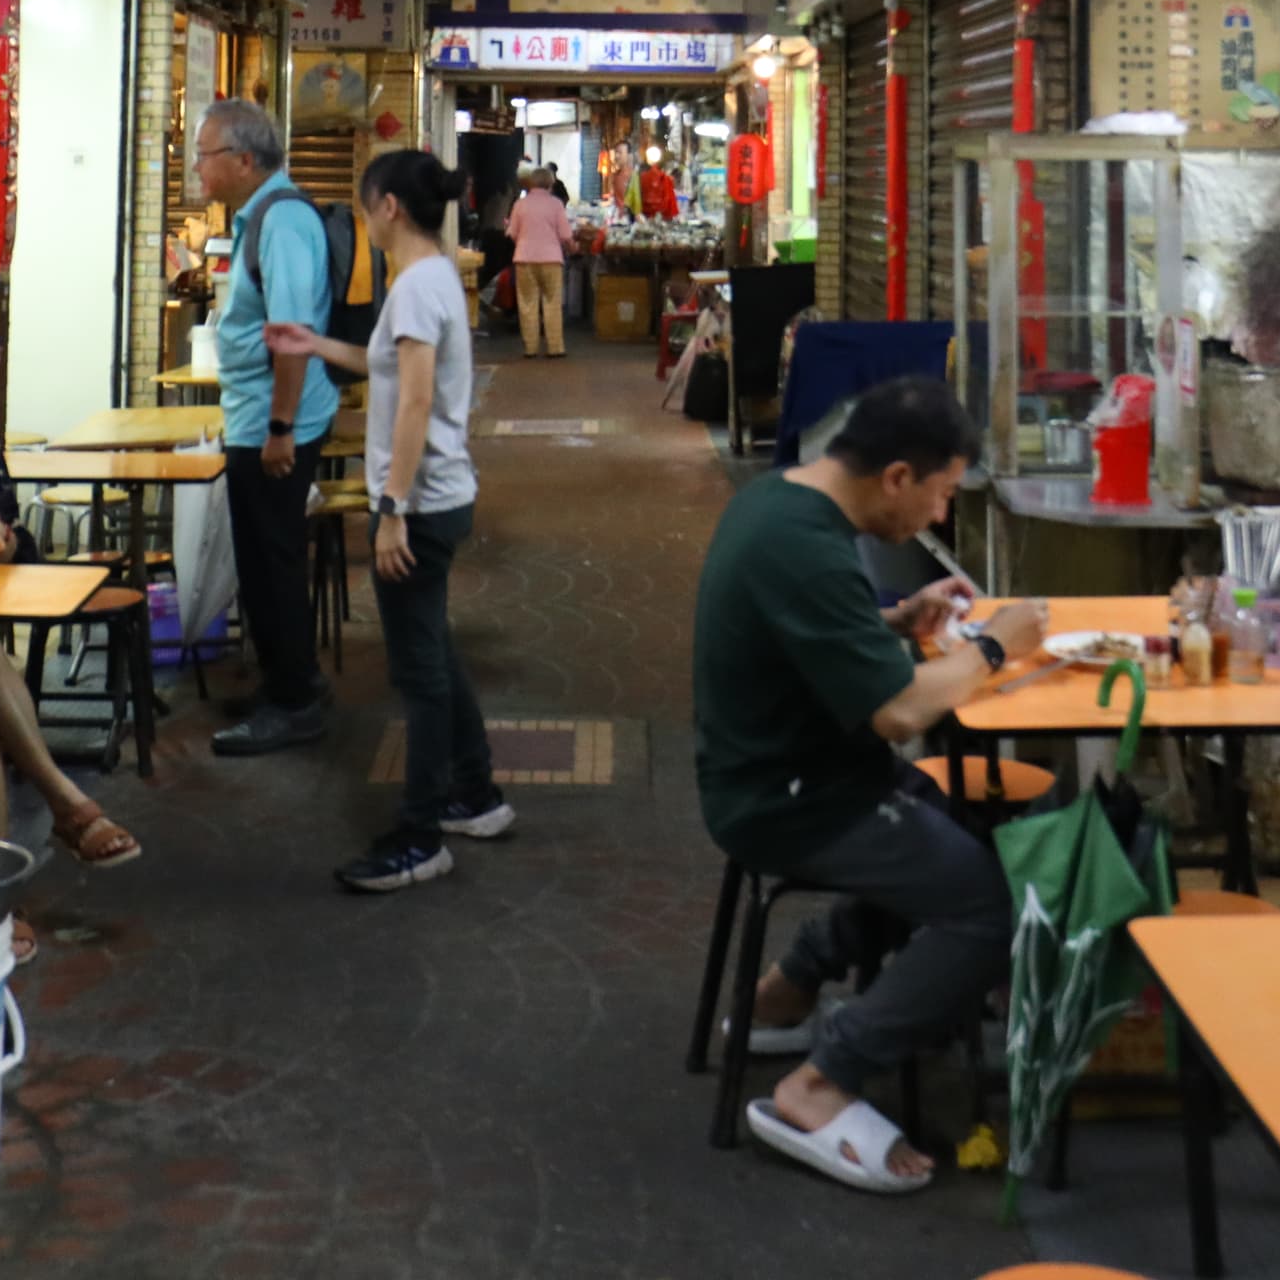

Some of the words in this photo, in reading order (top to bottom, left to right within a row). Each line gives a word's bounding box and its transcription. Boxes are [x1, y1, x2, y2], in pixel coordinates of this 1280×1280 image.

[527, 35, 569, 61] 公廁
[603, 39, 707, 63] 東門市場
